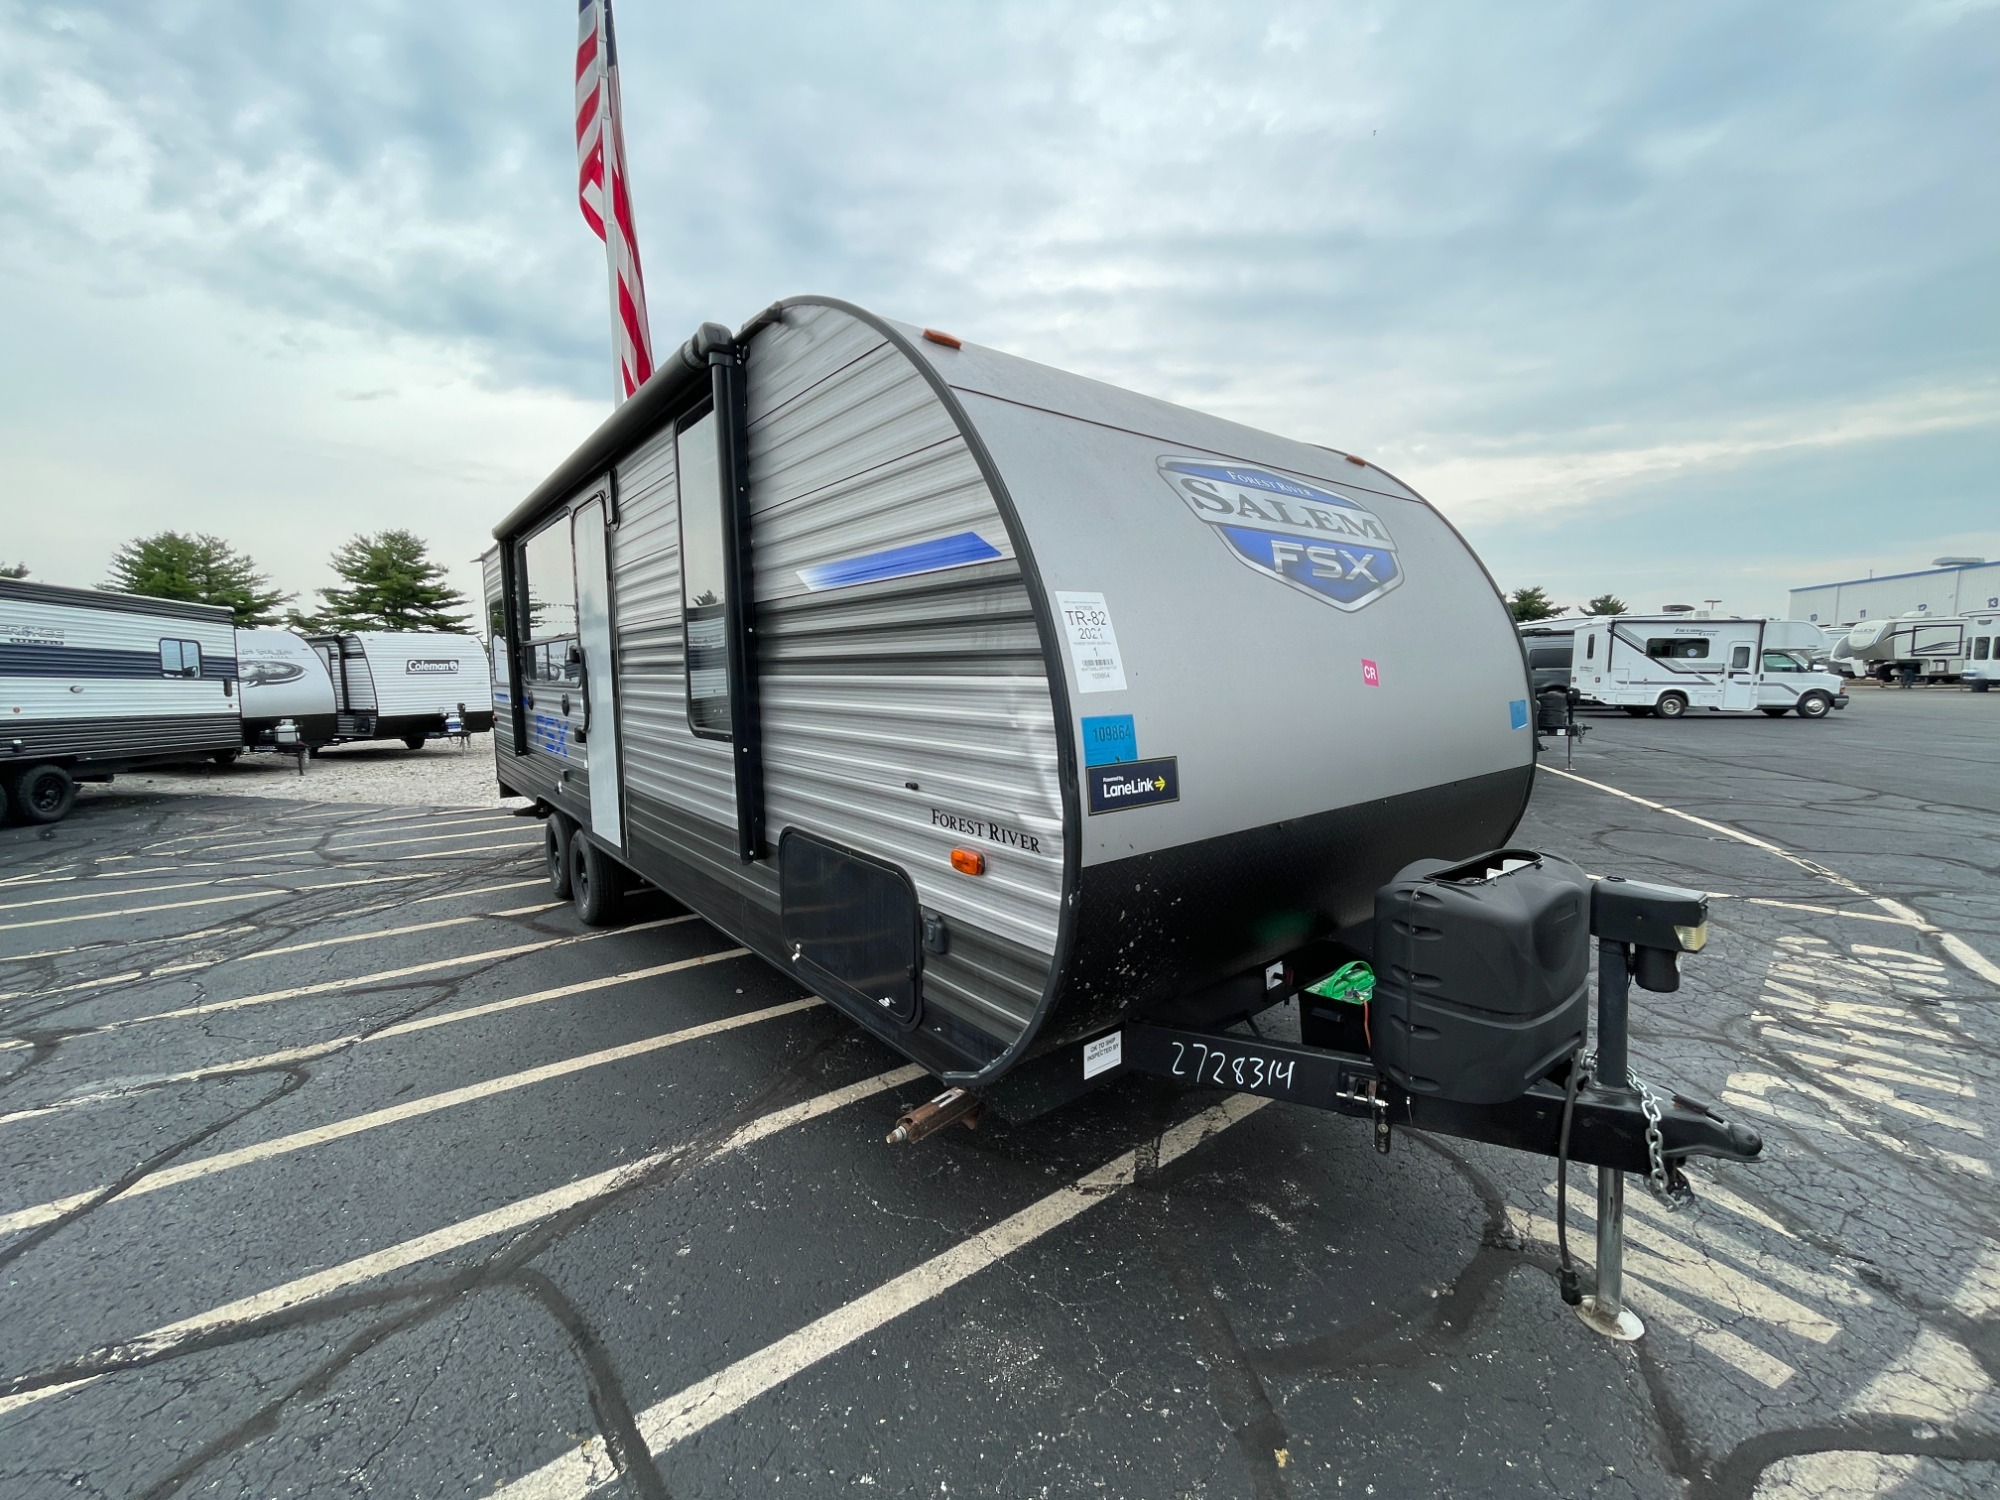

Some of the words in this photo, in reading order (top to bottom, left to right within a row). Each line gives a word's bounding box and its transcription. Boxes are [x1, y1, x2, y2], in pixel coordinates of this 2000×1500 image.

[1226, 470, 1276, 489] FOREST
[1276, 481, 1314, 497] RIVER
[1180, 477, 1390, 543] SALEM
[1270, 539, 1379, 584] FSX
[1987, 597, 1999, 608] 13
[1065, 610, 1107, 626] TR-82
[1859, 609, 1867, 619] 11
[1078, 627, 1103, 640] 2021
[1093, 646, 1098, 657] 1
[408, 660, 449, 671] Coleman
[1364, 664, 1377, 681] CR
[535, 714, 570, 758] FSX
[1093, 724, 1132, 742] 109864
[1103, 777, 1155, 799] LaneLink
[931, 808, 985, 838] FOREST
[987, 822, 1042, 853] RIVER
[1090, 1044, 1098, 1053] OK
[1098, 1041, 1105, 1049] TO
[1172, 1041, 1296, 1090] 2728314
